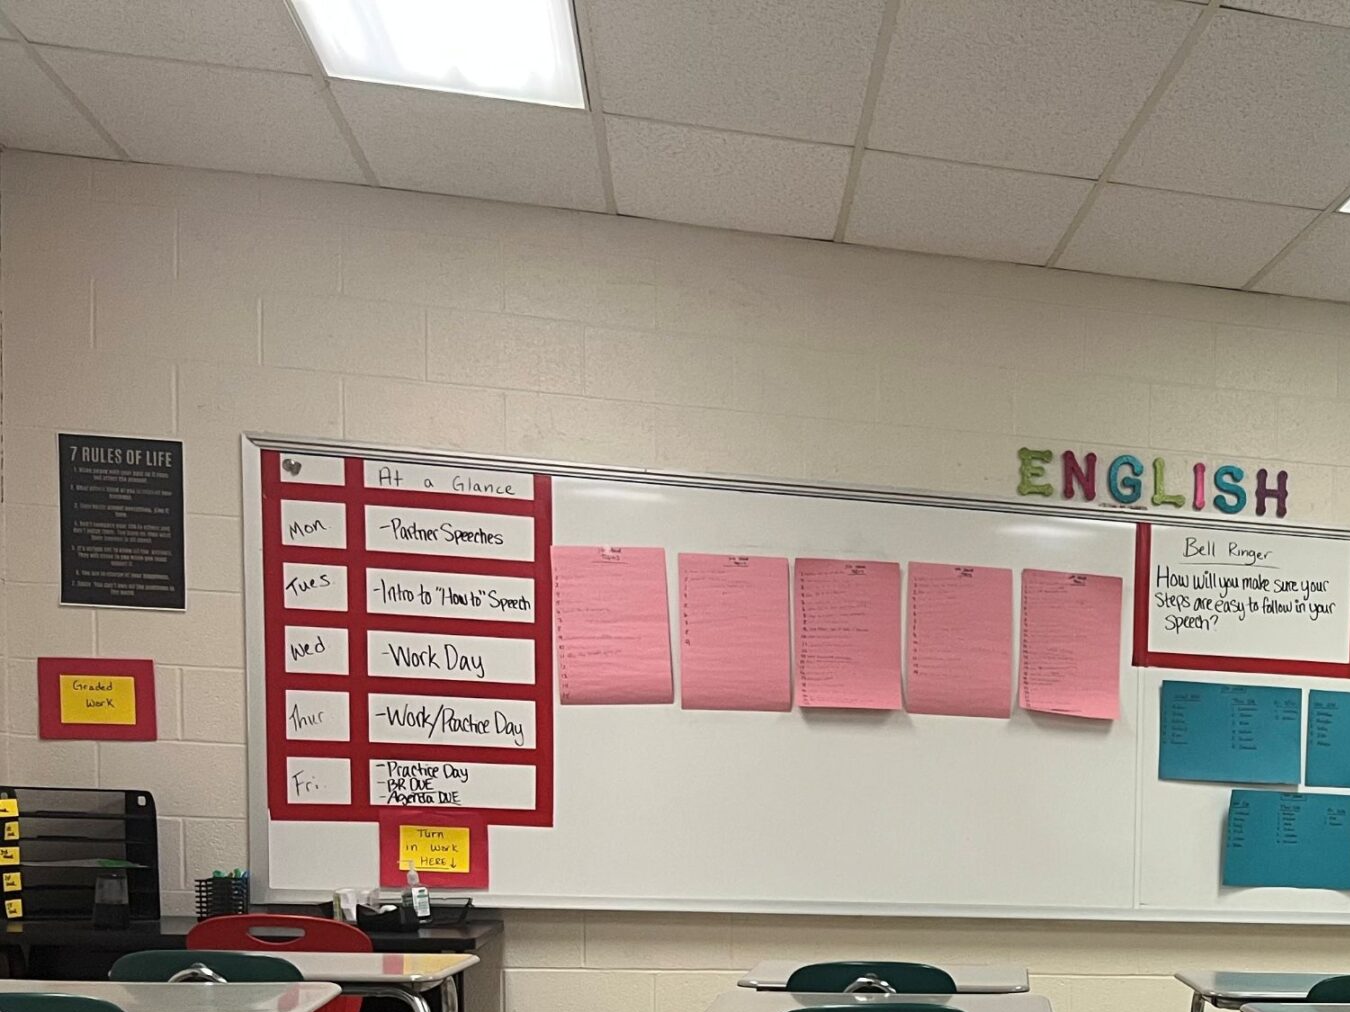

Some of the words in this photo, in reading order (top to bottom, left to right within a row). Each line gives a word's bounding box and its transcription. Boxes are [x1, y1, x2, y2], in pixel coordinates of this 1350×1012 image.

[69, 446, 77, 462] 7
[82, 446, 122, 465] RULES
[126, 449, 142, 465] OF
[146, 450, 172, 468] LIFE
[378, 466, 404, 487] At
[423, 477, 434, 489] a
[452, 475, 516, 496] Glance
[1017, 447, 1288, 518] ENGLISH
[440, 522, 504, 545] Speeches
[1183, 536, 1215, 558] Bell
[1228, 542, 1273, 566] Ringer
[1156, 564, 1189, 589] How
[1192, 570, 1216, 590] will
[1218, 577, 1239, 598] you
[1242, 574, 1270, 592] make
[1273, 578, 1298, 593] sure
[1301, 579, 1329, 600] your
[418, 584, 432, 605] to
[487, 589, 531, 612] Speech
[1193, 598, 1212, 612] are
[1214, 599, 1245, 621] easy
[1249, 601, 1259, 613] to
[1262, 597, 1293, 614] follow
[1295, 600, 1306, 613] in
[1309, 604, 1336, 621] your
[290, 635, 326, 661] Wed
[444, 643, 485, 679] Day
[72, 680, 113, 691] Graded
[494, 710, 525, 747] Day
[409, 778, 435, 792] DUE
[443, 763, 469, 783] Day
[438, 790, 461, 805] DUE
[417, 828, 444, 839] Turn
[421, 857, 446, 866] HERE
